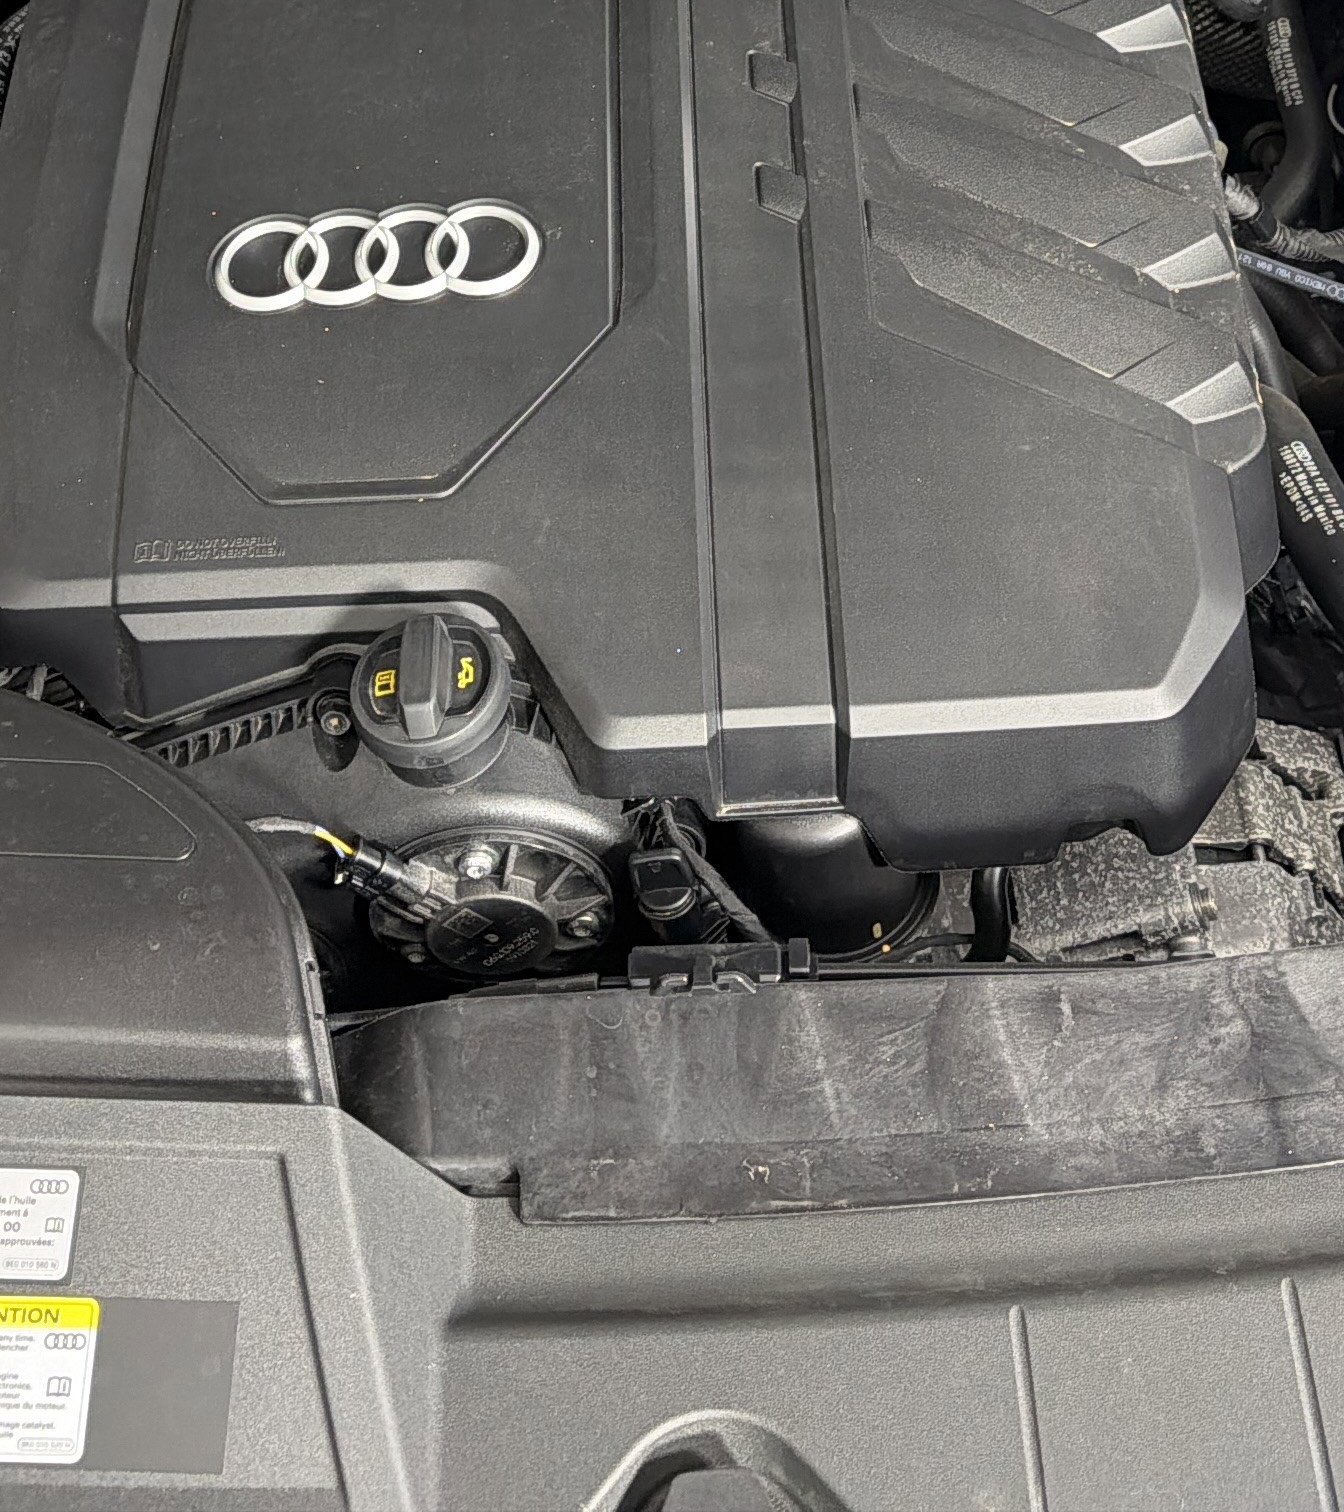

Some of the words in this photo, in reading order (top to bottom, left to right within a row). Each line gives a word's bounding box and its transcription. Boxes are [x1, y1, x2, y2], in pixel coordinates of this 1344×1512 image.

[1295, 472, 1314, 496] Made
[1313, 504, 1337, 536] Mexico
[3, 1221, 21, 1232] 00
[0, 1236, 55, 1248] approuvées:
